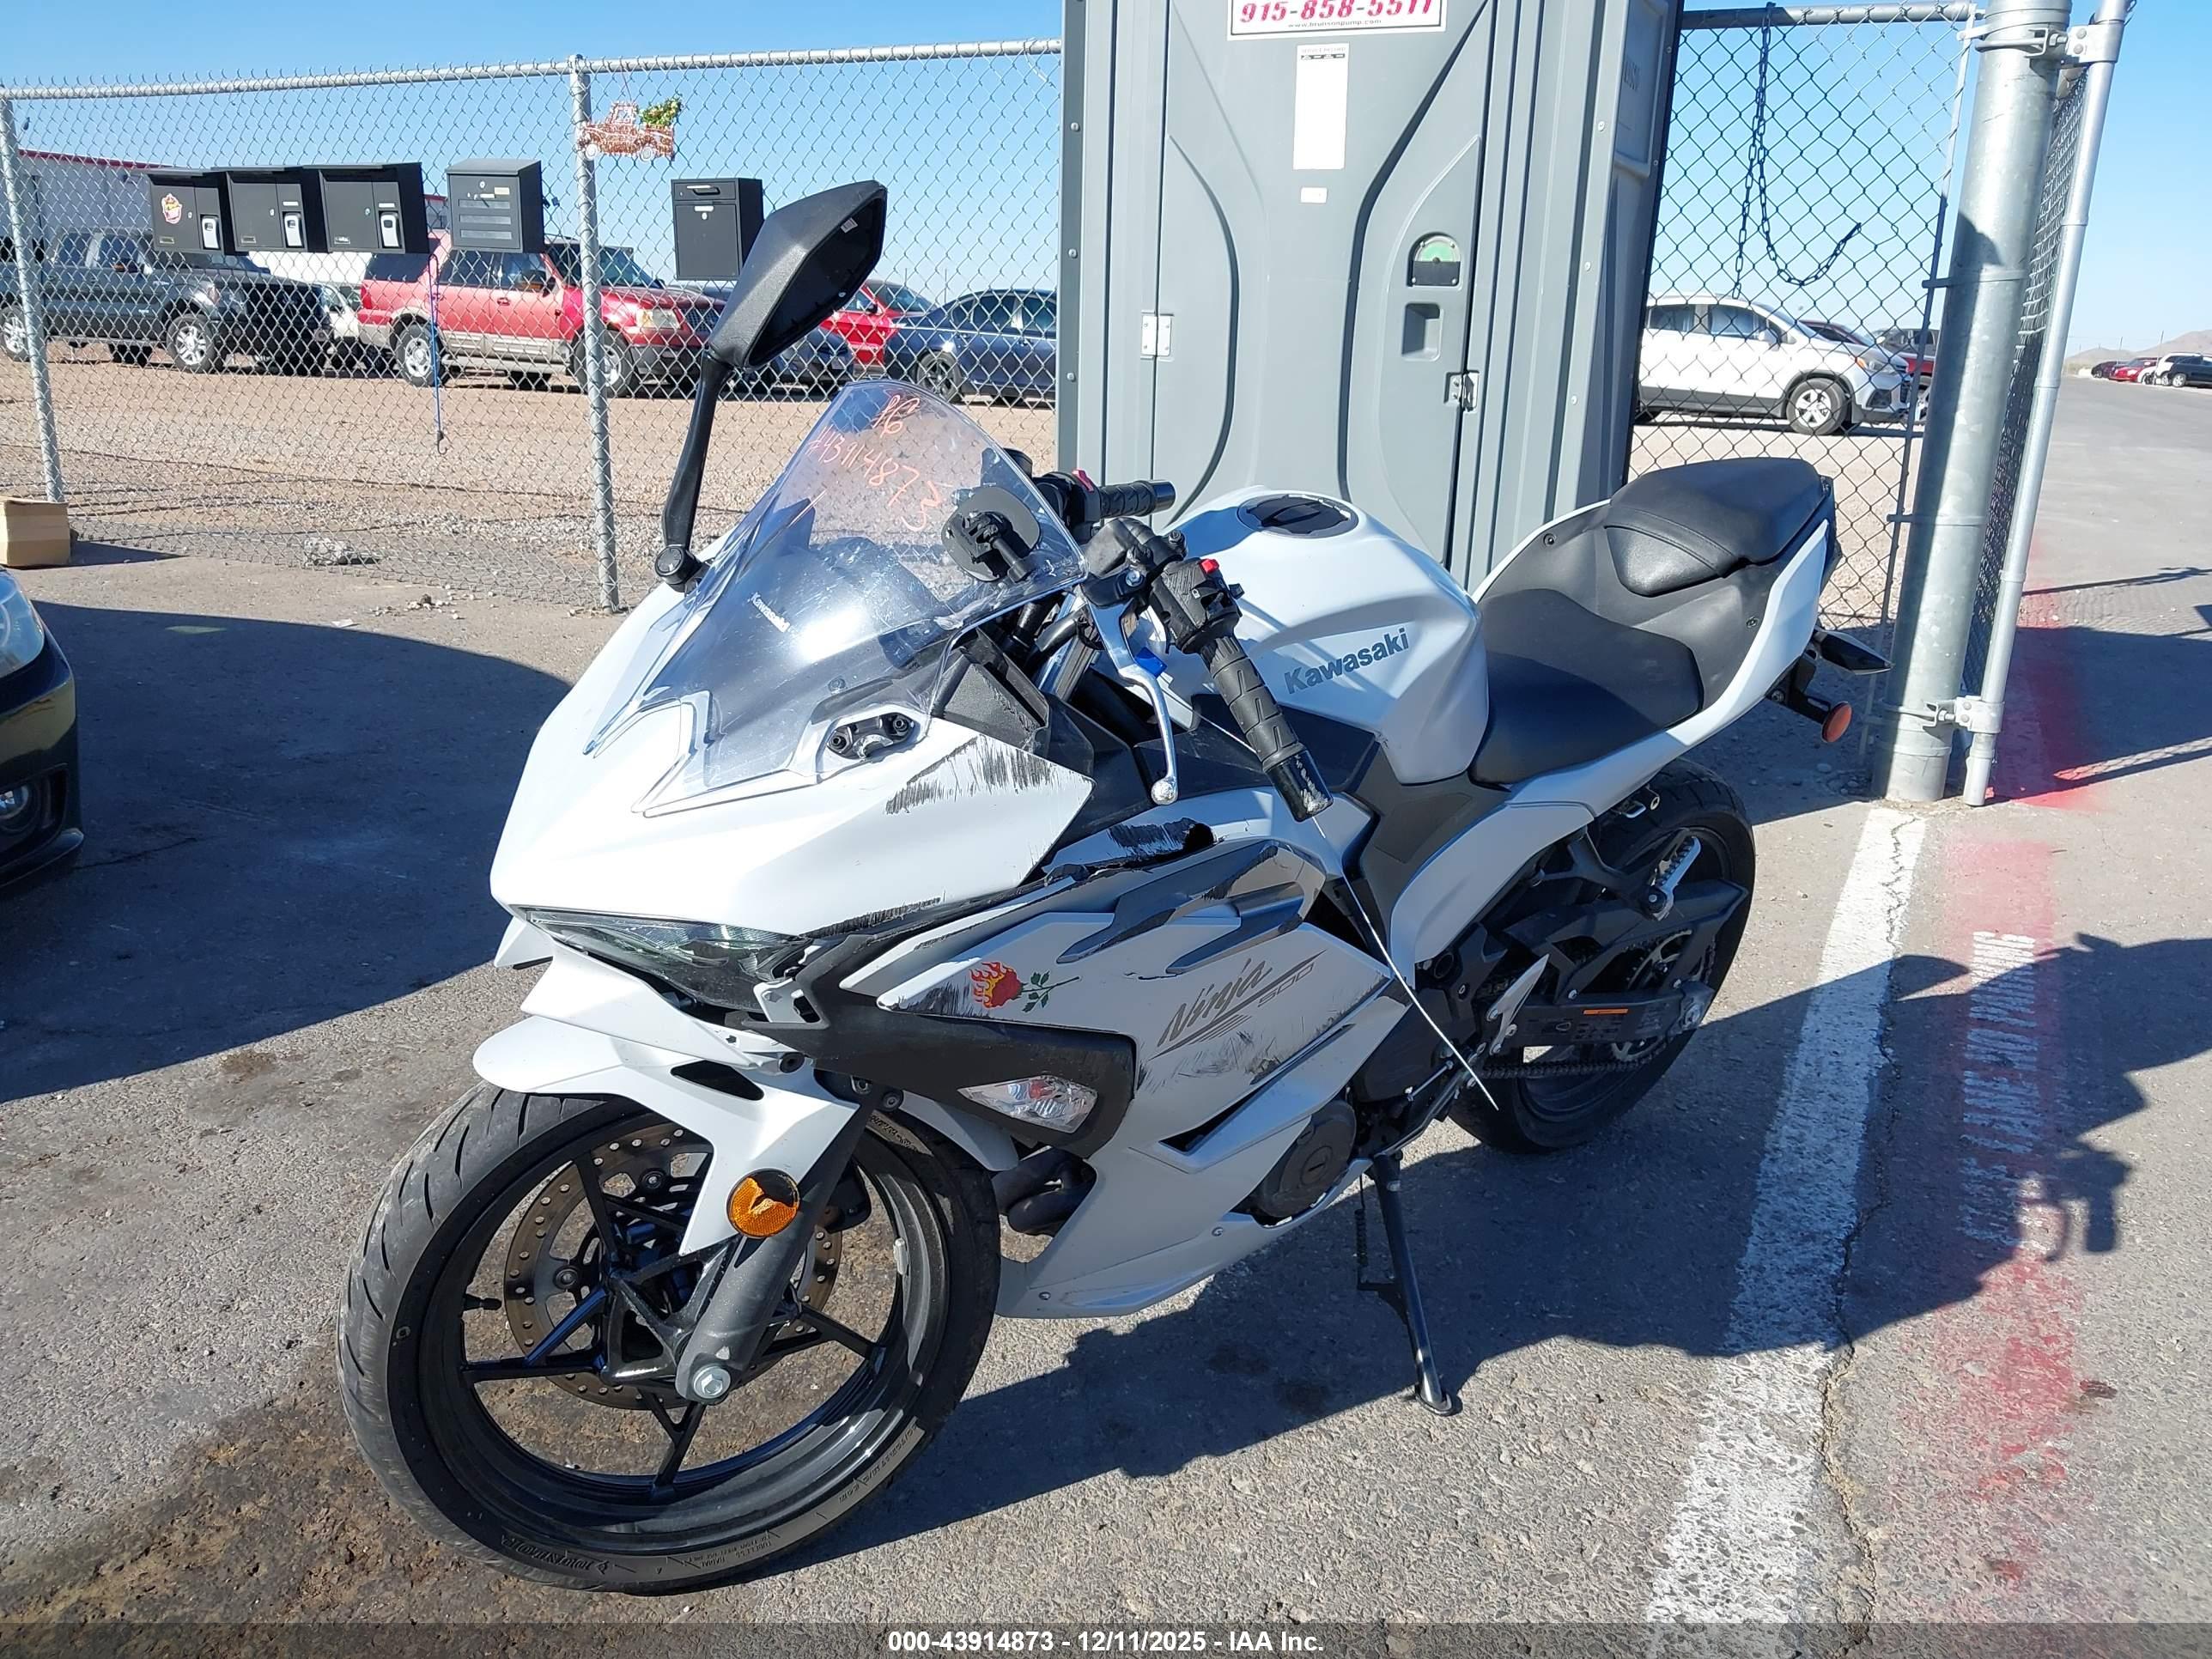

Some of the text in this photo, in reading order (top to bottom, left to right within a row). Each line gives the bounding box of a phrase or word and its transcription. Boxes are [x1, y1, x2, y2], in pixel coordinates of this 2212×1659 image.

[1240, 0, 1432, 22] 915-858-5511
[1284, 627, 1409, 695] Kawasaki
[1158, 957, 1273, 1047] Ninja
[1257, 962, 1316, 1007] 500
